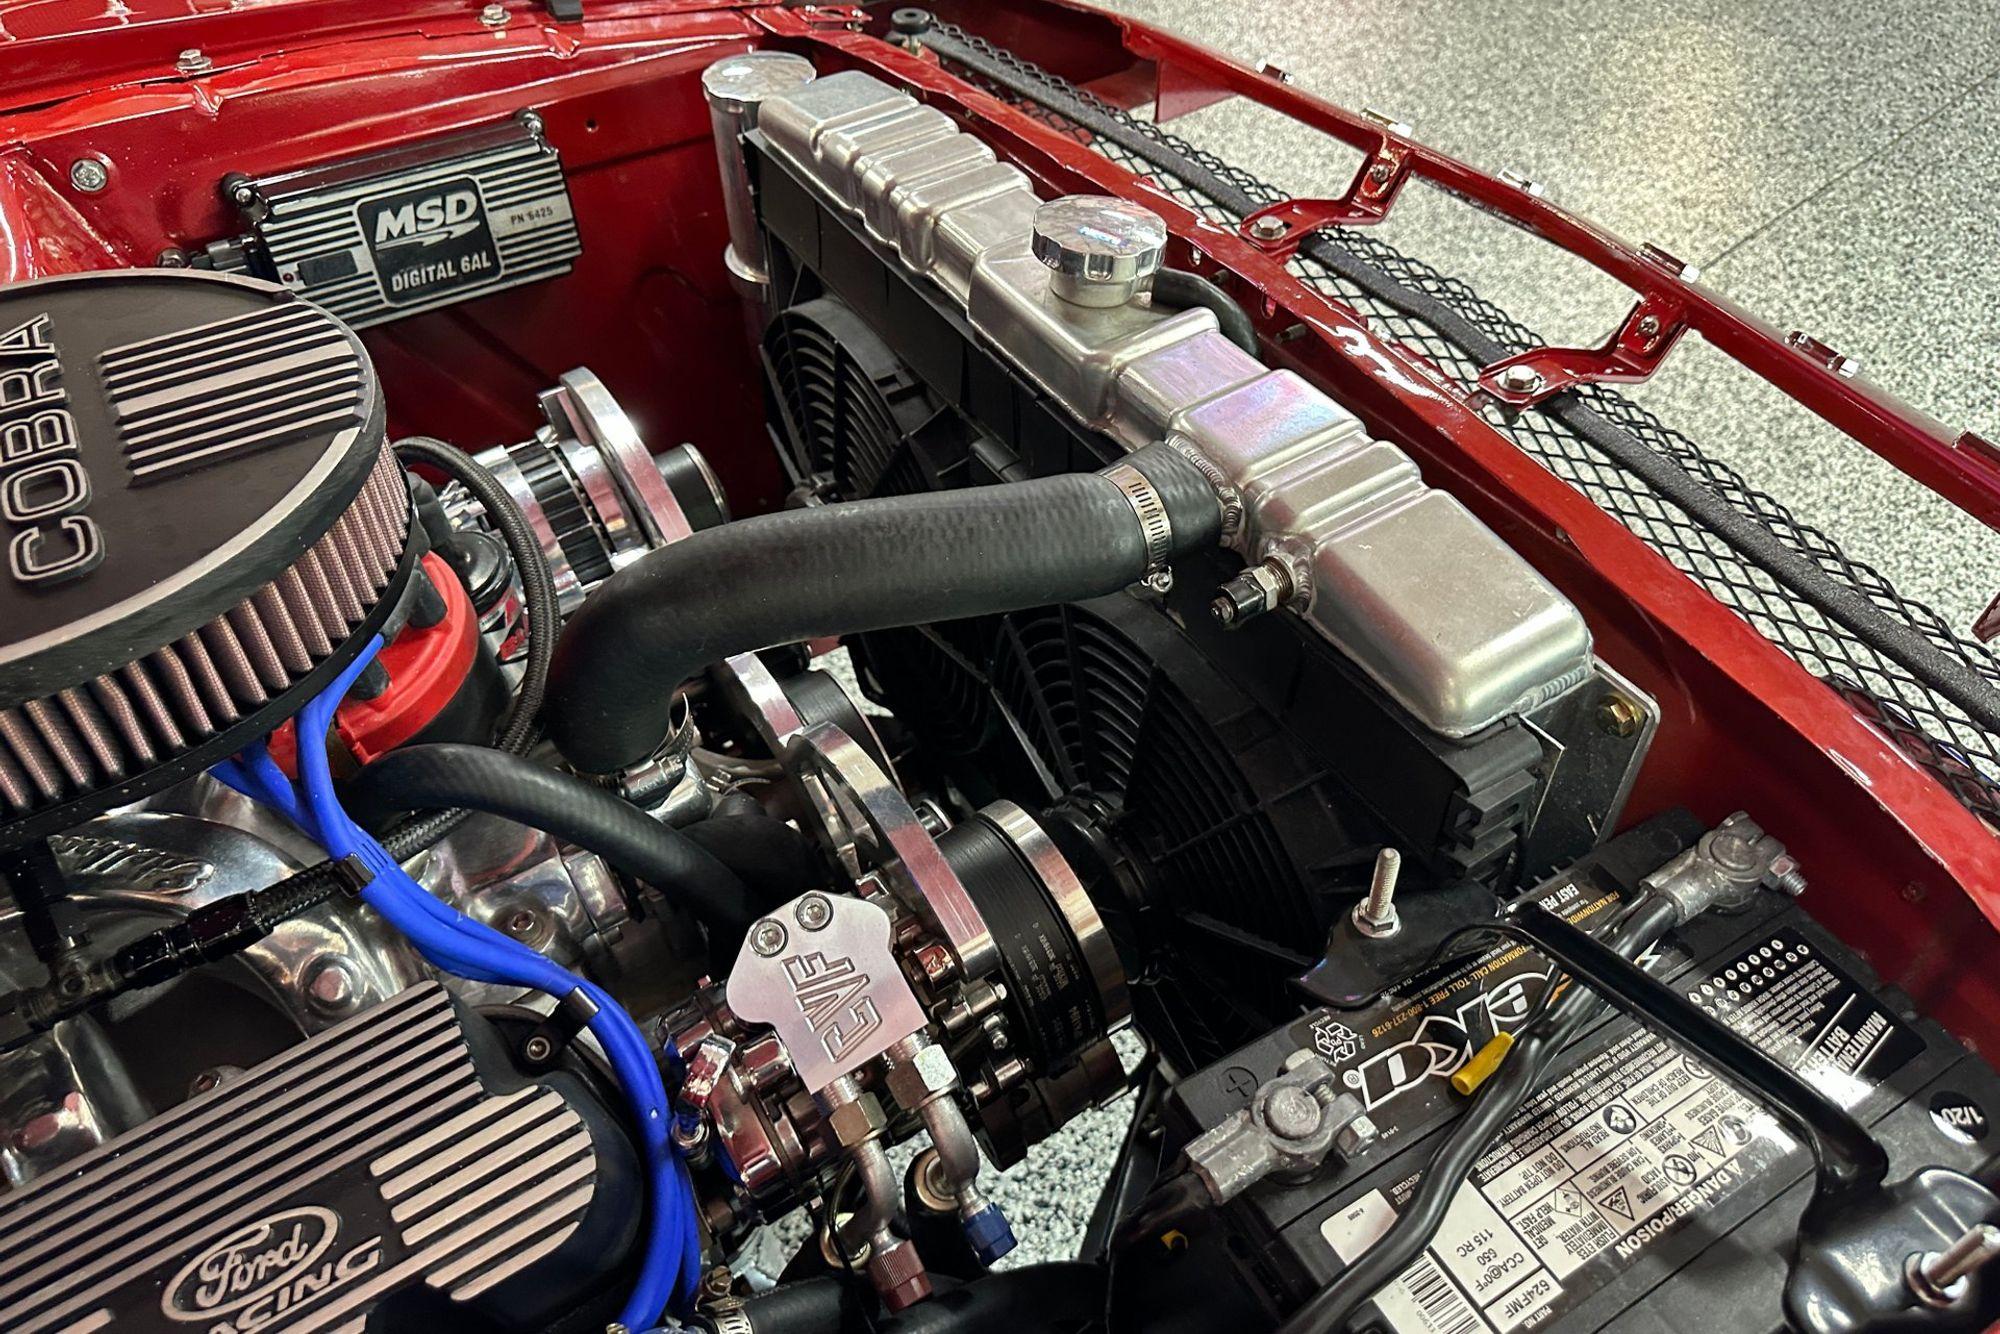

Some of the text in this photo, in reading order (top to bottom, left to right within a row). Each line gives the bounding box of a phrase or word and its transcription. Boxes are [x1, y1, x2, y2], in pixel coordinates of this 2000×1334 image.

[375, 191, 478, 244] MSD
[510, 214, 525, 226] PN
[392, 251, 492, 292] DIGITAL 6AL
[0, 312, 100, 581] COBRA
[1536, 880, 1580, 913] EAST PEN
[1603, 888, 1620, 903] FOR
[1485, 943, 1528, 972] FORMATION
[1426, 987, 1451, 1005] FREE
[1446, 976, 1471, 994] TOLL
[780, 951, 884, 1064] CVF
[1369, 999, 1429, 1039] 1-800-237-6126
[1329, 1035, 1342, 1047] Pb
[1805, 1025, 1850, 1071] BATTER
[1830, 1010, 1887, 1071] MAINTENA
[1645, 1072, 1692, 1108] KEEP OUT OF THE
[1656, 1077, 1667, 1089] OF
[1553, 1097, 1580, 1119] FOLLOW
[1940, 1105, 1985, 1126] 1/20
[1579, 1127, 1610, 1153] READ ALL
[1624, 1145, 1638, 1159] OR
[1517, 1150, 1557, 1182] DO NOT TIP.
[1630, 1154, 1646, 1168] CAN
[1639, 1167, 1658, 1185] ACID
[1495, 1158, 1565, 1210] DO NOT OPEN BATTERY.
[1635, 1177, 1668, 1205] SULFURIC
[1514, 1200, 1554, 1232] HELP FAST.
[1522, 1213, 1556, 1242] MEDICAL
[1554, 1208, 1600, 1246] WITH WATER.
[1613, 1168, 1731, 1259] DANGER/POISON
[1454, 1226, 1494, 1259] 115 RC
[1530, 1233, 1549, 1250] GET
[1561, 1218, 1608, 1256] IMMEDIATELY
[1575, 1227, 1616, 1261] FLUSH EYES
[195, 1222, 310, 1308] Ford
[1474, 1245, 1498, 1267] 650
[1500, 1277, 1551, 1319] 624FMF
[1520, 1302, 1553, 1331] PART NO.
